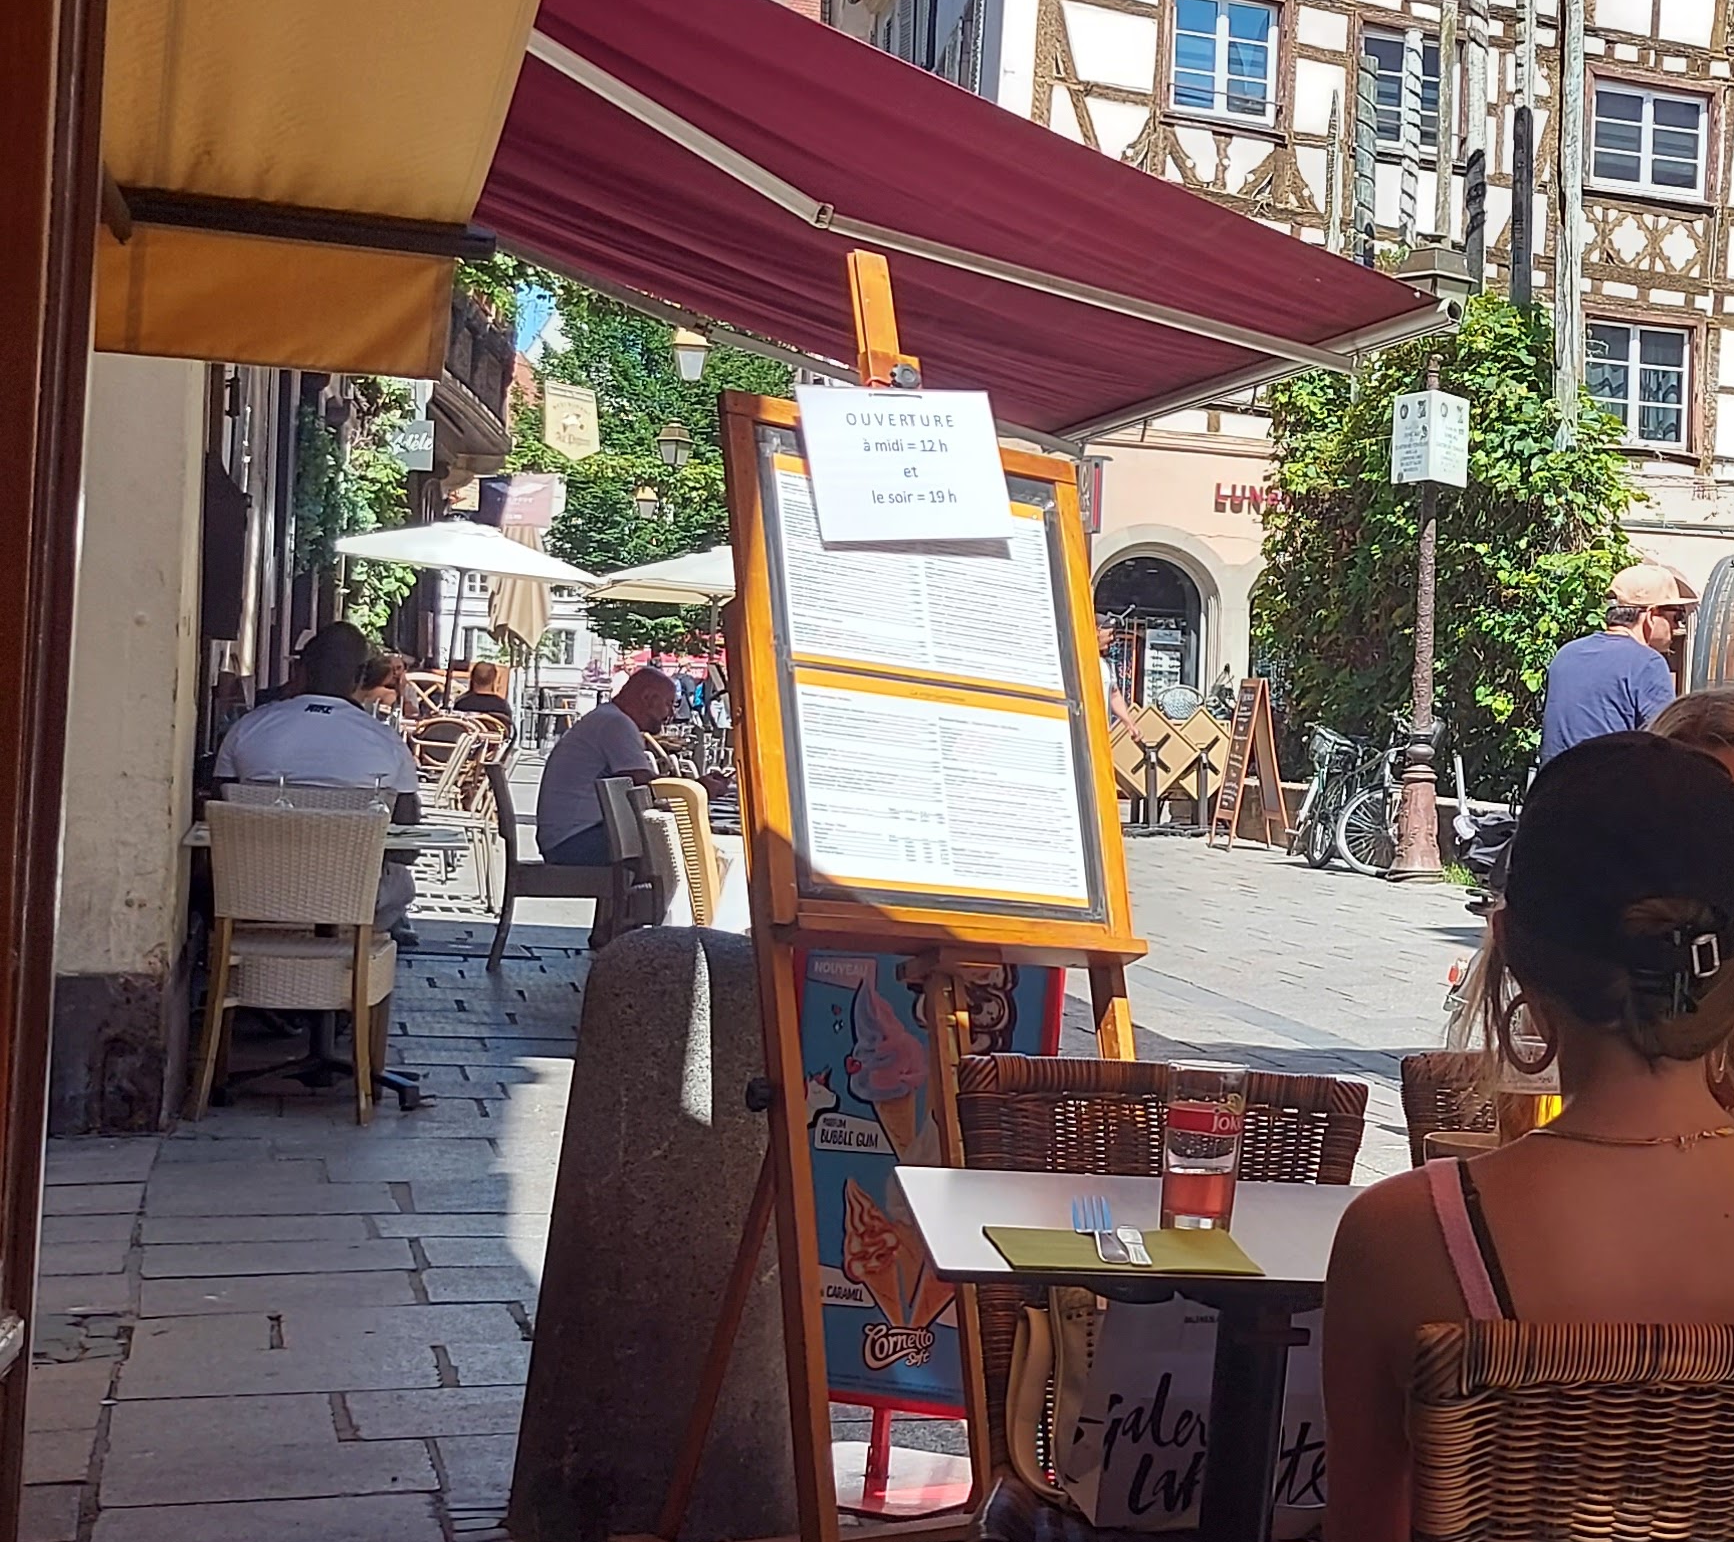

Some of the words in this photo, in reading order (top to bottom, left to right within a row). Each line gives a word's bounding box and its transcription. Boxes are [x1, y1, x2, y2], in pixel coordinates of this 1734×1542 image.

[845, 412, 955, 428] OUVERTURE
[863, 437, 871, 452] à
[875, 438, 904, 453] midi
[920, 439, 937, 452] 12
[939, 439, 948, 452] h
[903, 466, 918, 478] et
[871, 489, 884, 504] le
[888, 489, 913, 504] soir
[929, 490, 945, 504] 19
[948, 488, 957, 504] h
[814, 961, 869, 976] NOUVEAU
[820, 1128, 853, 1147] BUBBLE
[856, 1132, 879, 1149] GUM
[826, 1285, 864, 1303] CARAMEL
[864, 1323, 935, 1371] Cornetto
